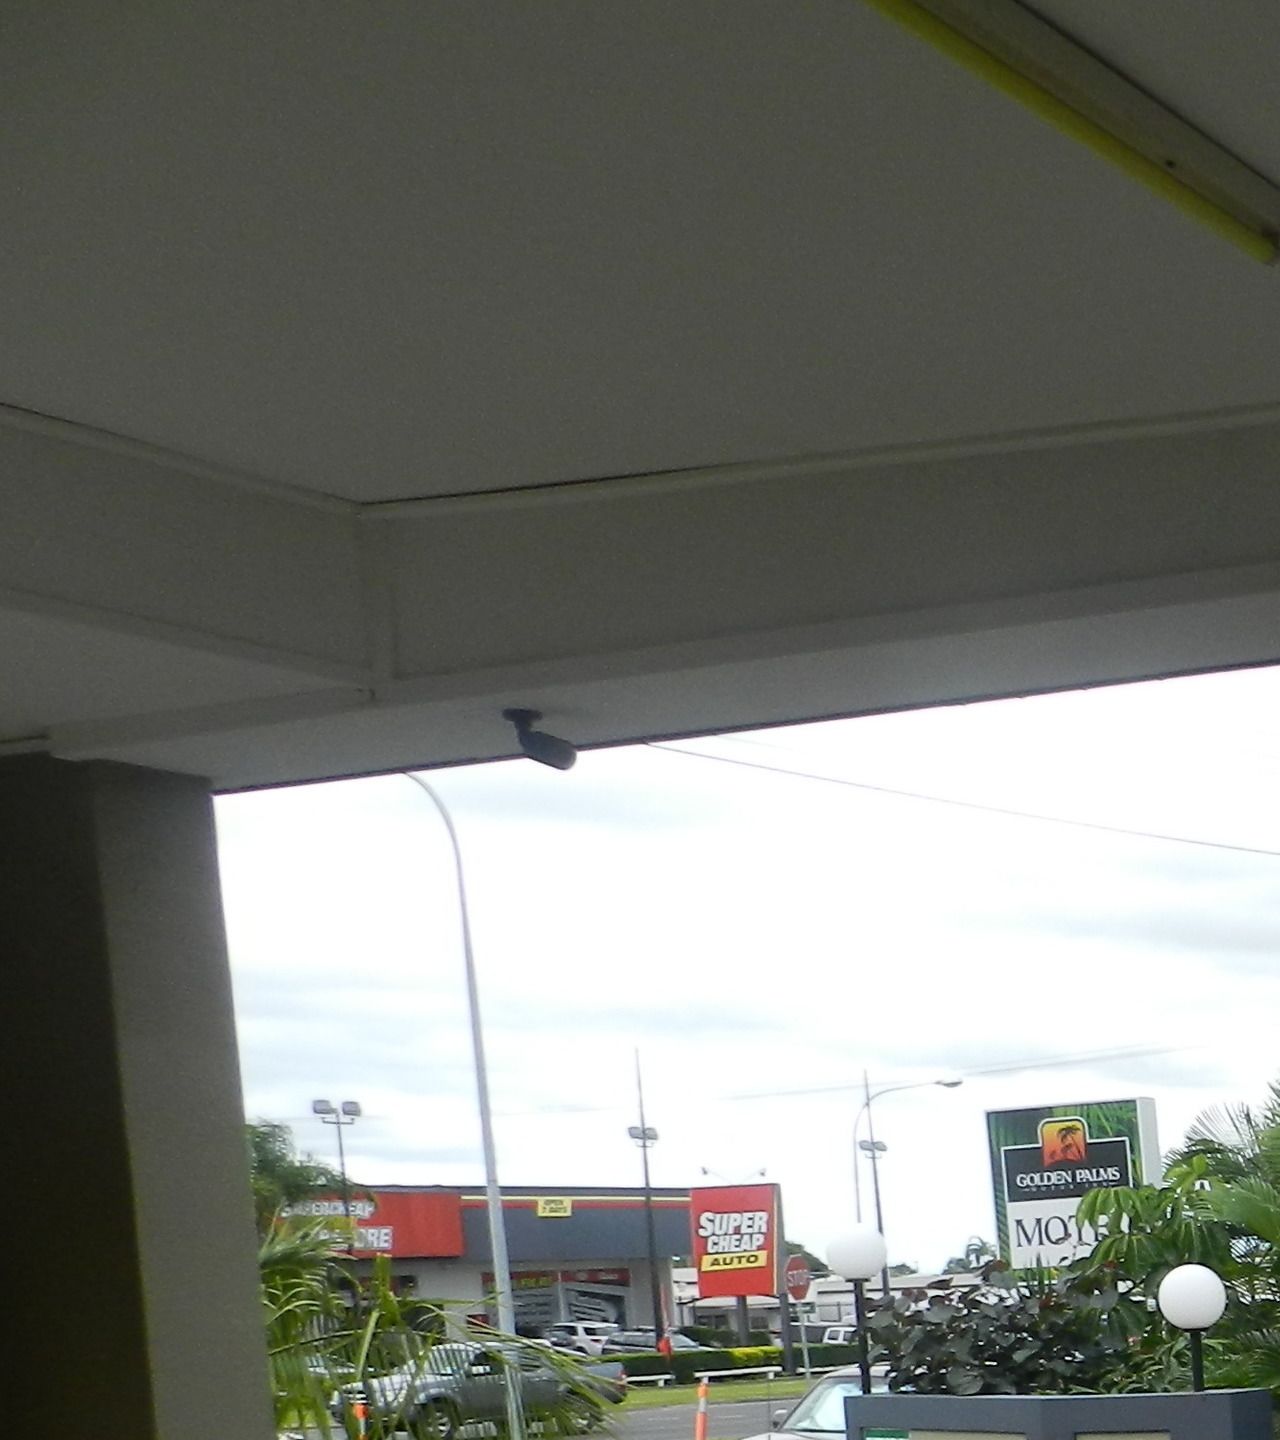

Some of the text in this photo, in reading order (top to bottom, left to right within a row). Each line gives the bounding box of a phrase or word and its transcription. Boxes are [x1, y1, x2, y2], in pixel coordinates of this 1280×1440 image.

[1016, 1167, 1120, 1187] GOLDEN PALMS
[698, 1211, 768, 1237] SUPER
[1015, 1213, 1132, 1247] MOTE
[707, 1233, 765, 1253] CHEAP
[710, 1254, 758, 1266] AUTO
[787, 1269, 809, 1287] STOP
